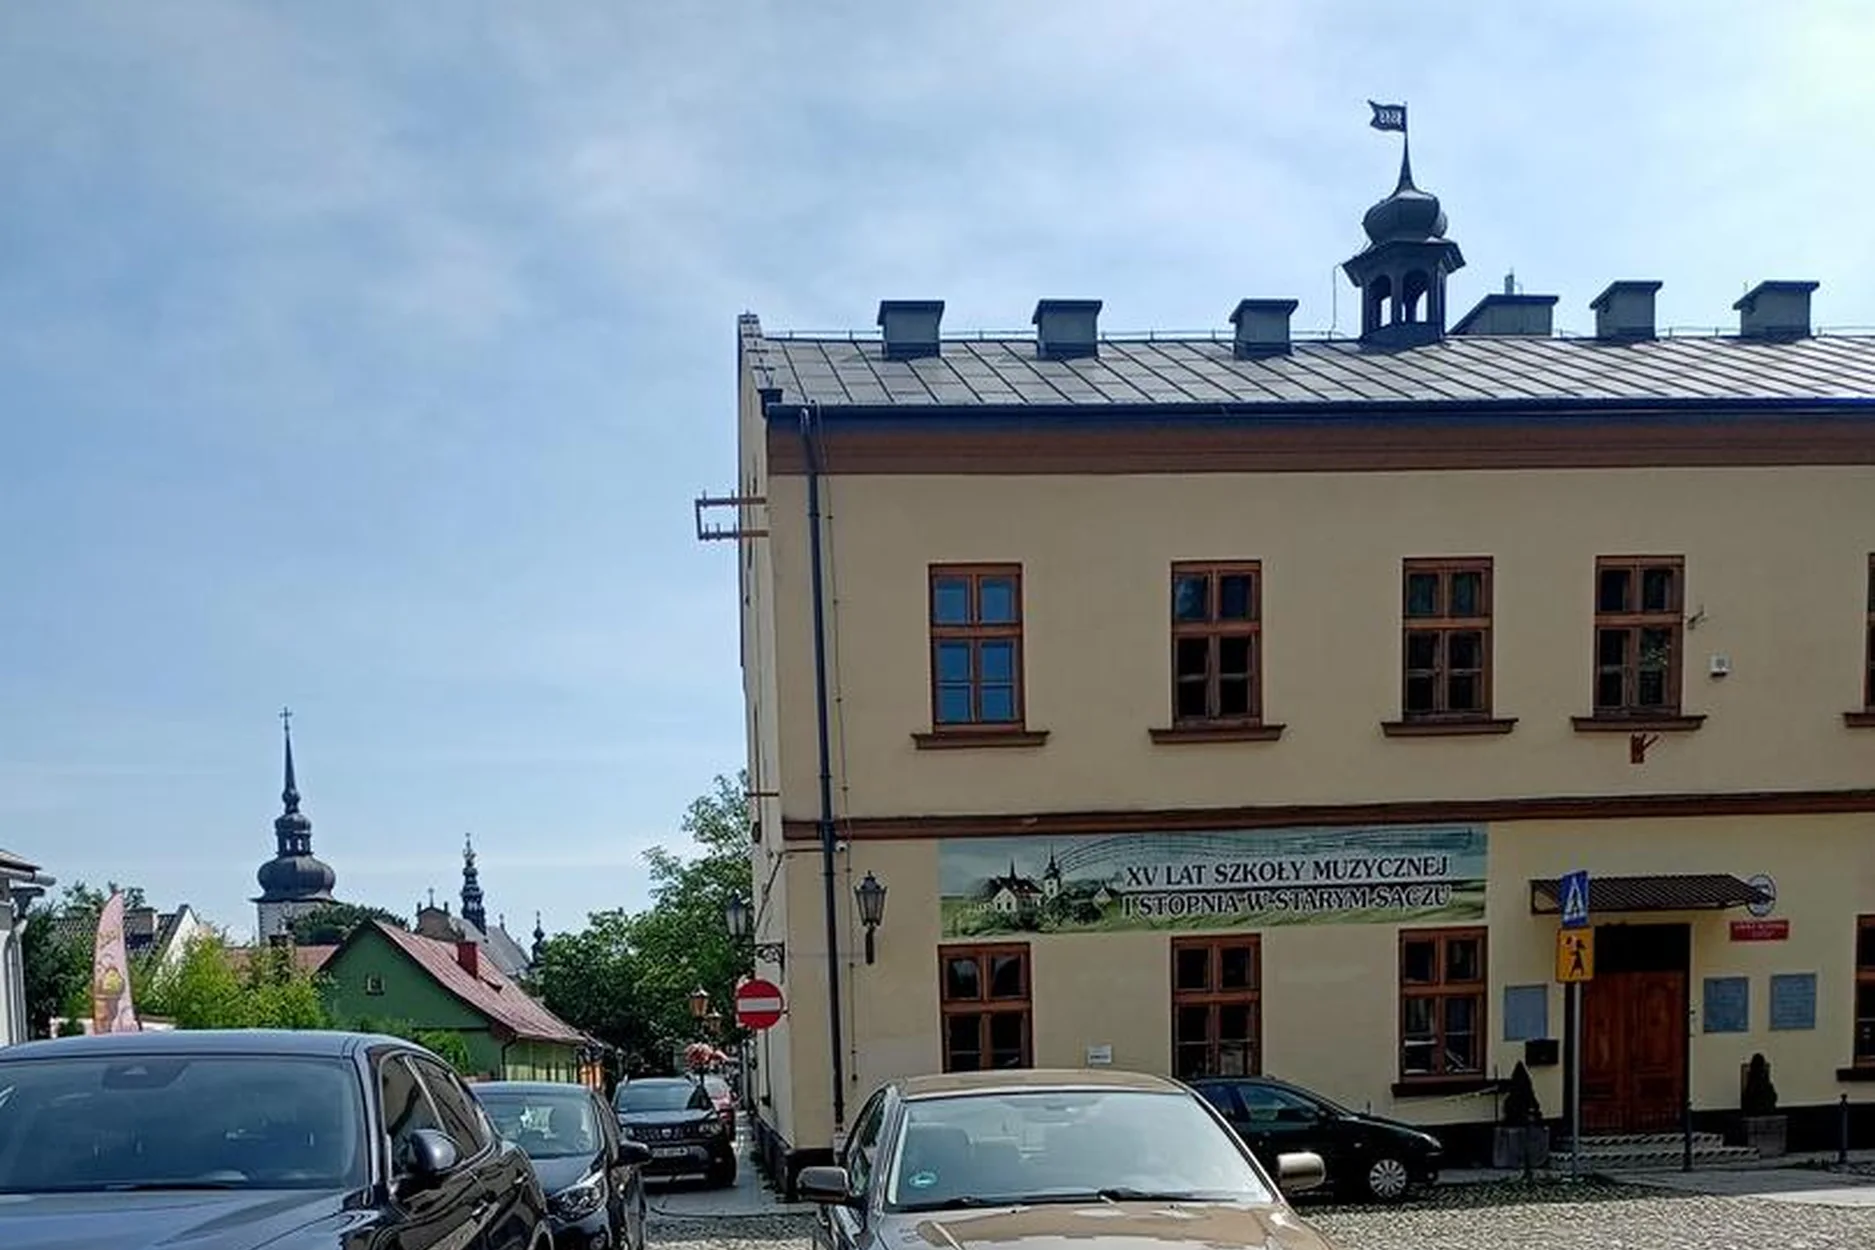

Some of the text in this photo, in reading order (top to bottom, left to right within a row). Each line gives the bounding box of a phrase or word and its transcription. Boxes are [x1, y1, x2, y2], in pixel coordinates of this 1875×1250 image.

[1126, 856, 1448, 886] XV LAT SZKOŁY MUZYCZNEJ
[1139, 893, 1239, 916] STOPNIA
[1247, 892, 1270, 912] W
[1275, 889, 1367, 911] STARYM
